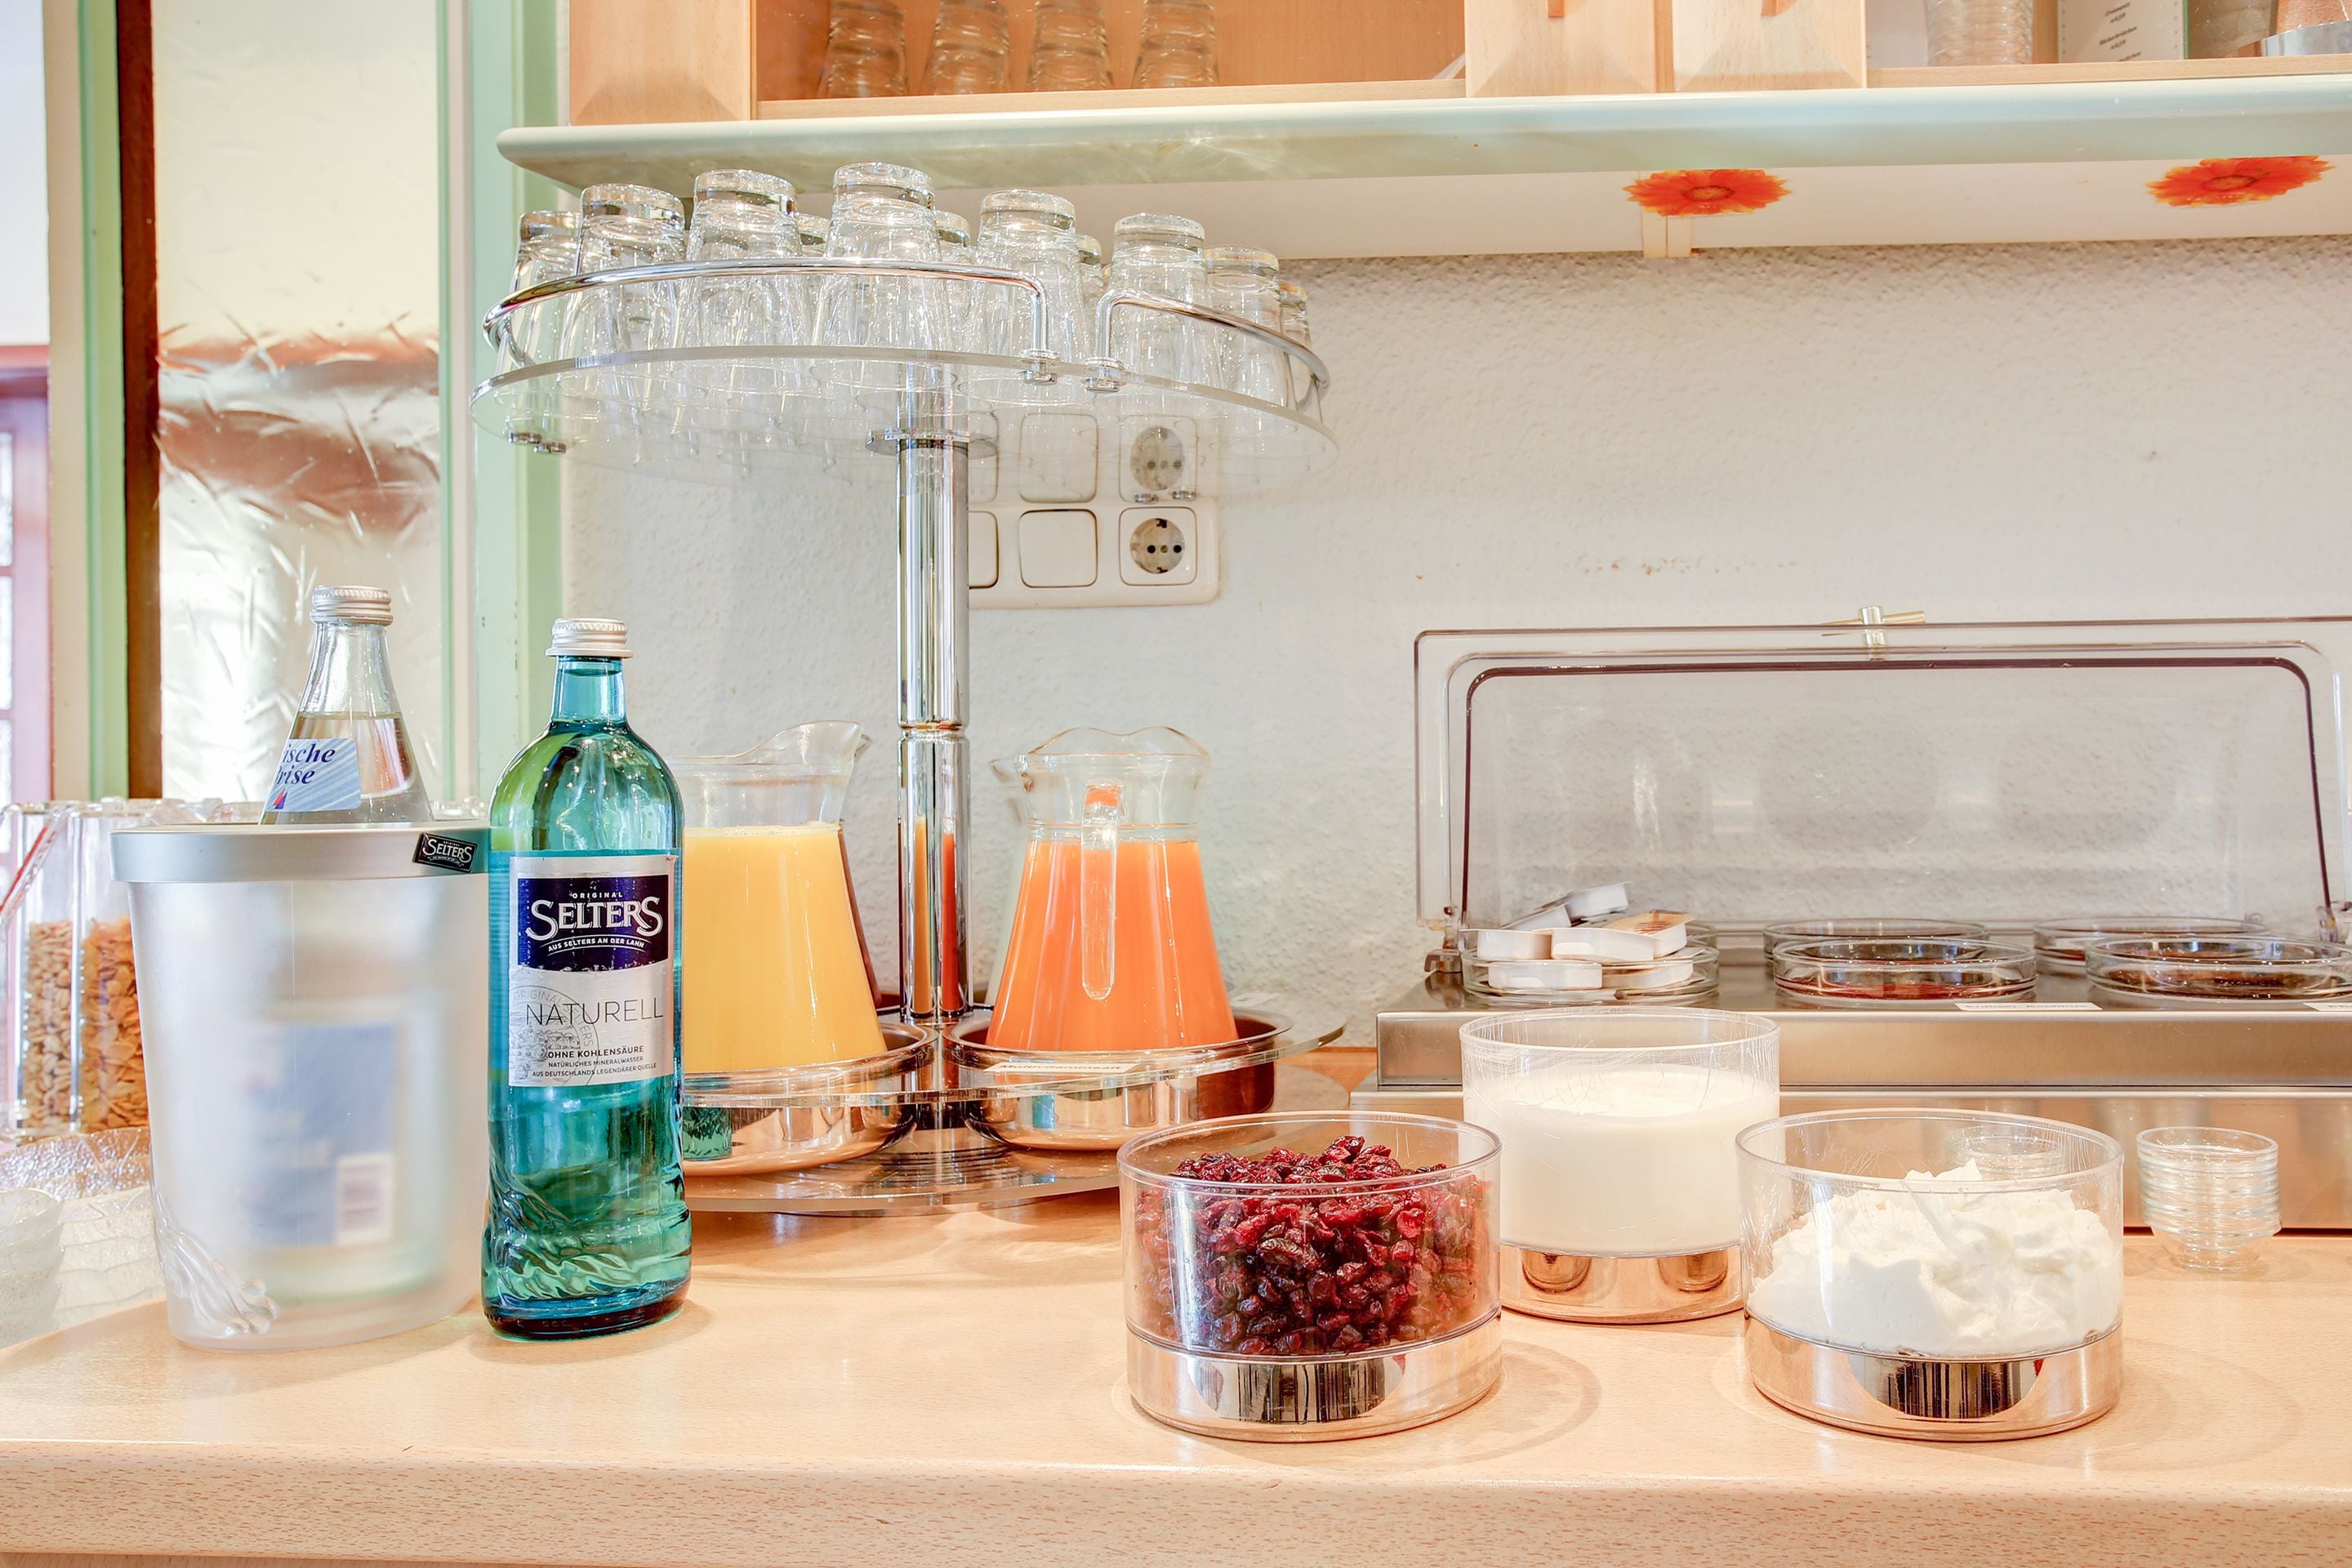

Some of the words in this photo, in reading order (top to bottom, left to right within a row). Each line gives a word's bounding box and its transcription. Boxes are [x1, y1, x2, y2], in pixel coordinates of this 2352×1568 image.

[275, 764, 315, 784] rise
[422, 839, 473, 863] SELTERS
[525, 897, 663, 941] SELTERS
[548, 943, 563, 952] AUS
[564, 938, 596, 947] SELTERS
[626, 939, 645, 948] LAHN
[526, 997, 663, 1026] NATURELL
[548, 1050, 575, 1058] OHNE
[577, 1045, 644, 1058] KOHLENSÄURE
[545, 1069, 595, 1077] DEUTSCHLANDS
[596, 1065, 636, 1075] LEGENDÄRER
[637, 1062, 657, 1071] QUELLE
[593, 1056, 644, 1067] MINERALWASSER
